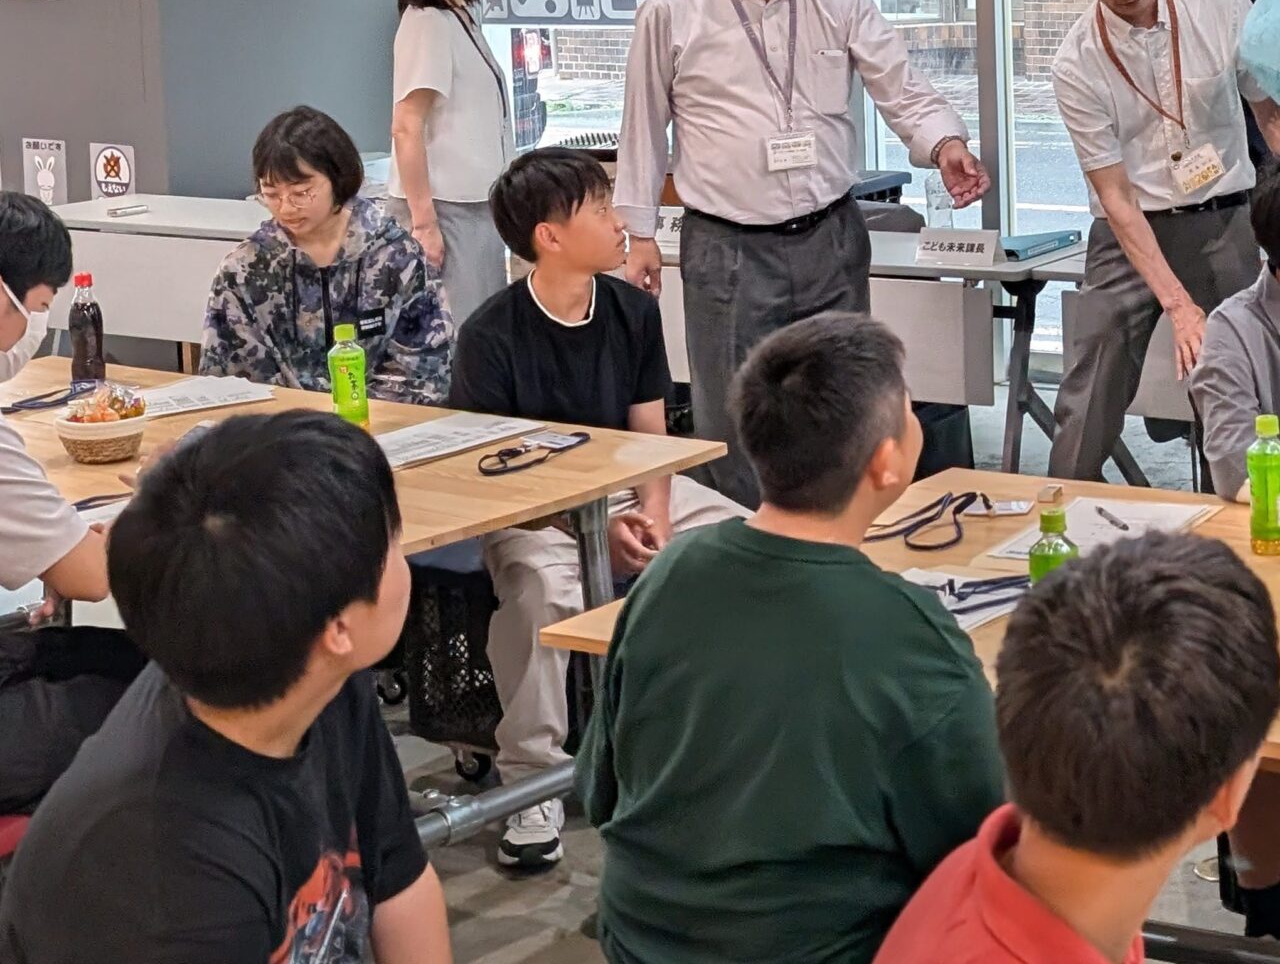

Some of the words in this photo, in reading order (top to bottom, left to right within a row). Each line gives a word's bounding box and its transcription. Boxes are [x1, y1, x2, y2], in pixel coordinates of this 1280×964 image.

[101, 183, 126, 193] もえない
[922, 241, 985, 254] こども未来課長
